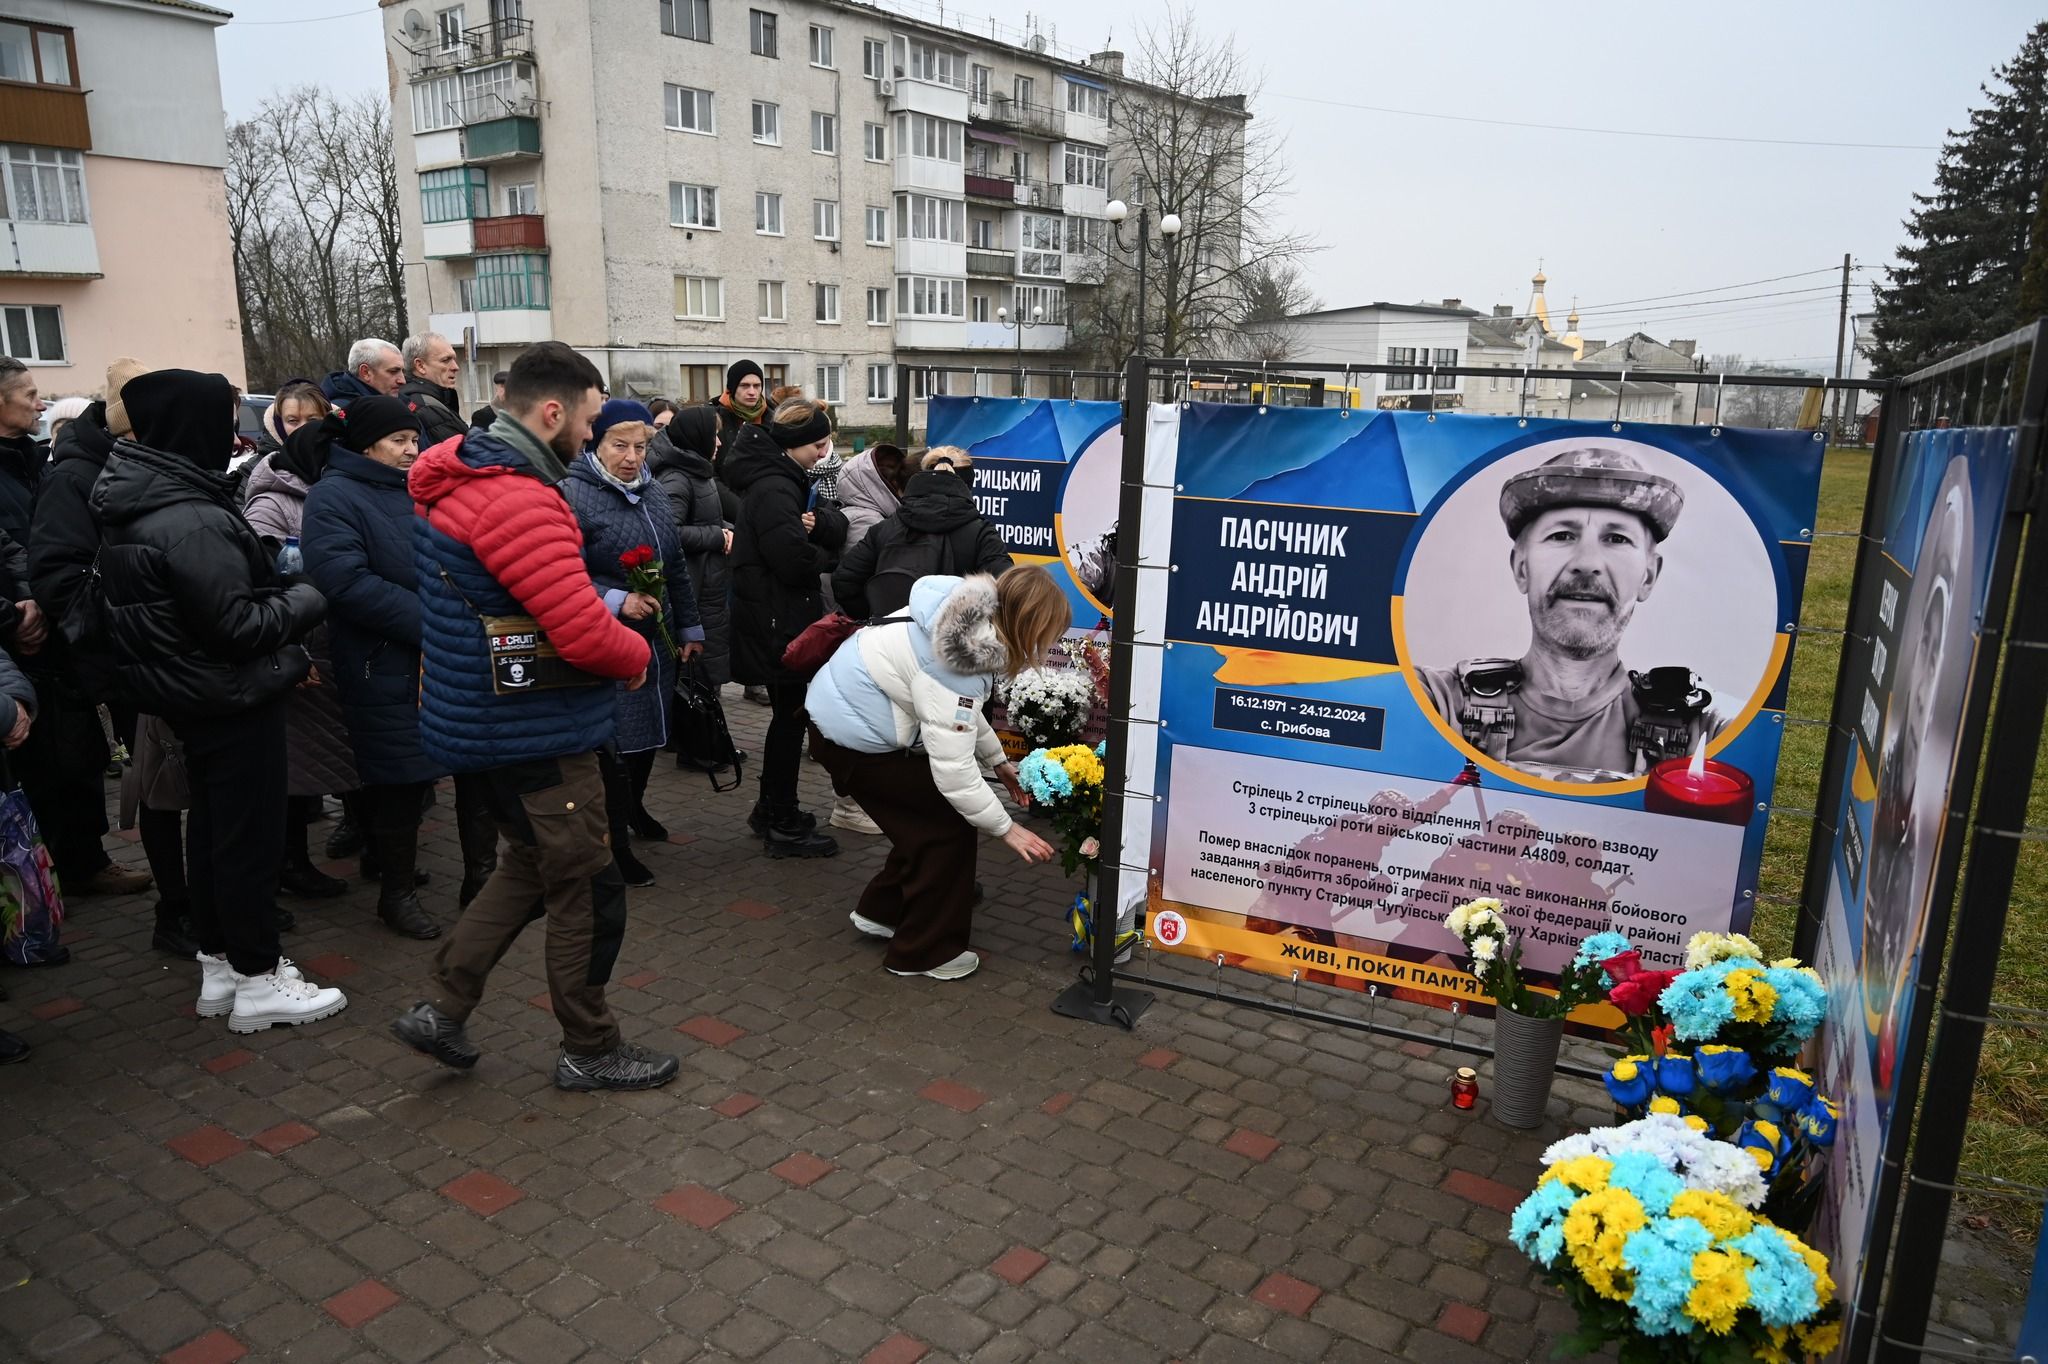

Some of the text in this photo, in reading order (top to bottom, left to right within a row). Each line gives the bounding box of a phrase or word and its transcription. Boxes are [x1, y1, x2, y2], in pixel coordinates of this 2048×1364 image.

[972, 468, 1041, 492] РИЦЬКИЙ
[1220, 516, 1349, 558] ПАСІЧНИК
[1230, 561, 1328, 600] АНДРІЙ
[1196, 600, 1359, 647] АНДРІЙОВИЧ
[1230, 695, 1287, 712] 16.12.1971
[1299, 704, 1367, 722] 24.12.2024
[1260, 720, 1331, 739] с. Грибова
[1232, 780, 1659, 862] Стрілець 2 стрілецького відділення 1 стрілецького взводу
[1248, 801, 1634, 876] 3 стрілецької роти військової частини А4809, солдат.
[1198, 830, 1688, 926] Помер внаслідок поранень, отриманих під час виконання бойового
[1199, 851, 1260, 871] завдання
[1263, 862, 1271, 873] з
[1274, 863, 1332, 884] відбиття
[1335, 873, 1399, 895] збройної
[1401, 886, 1450, 904] агресії
[1533, 907, 1612, 933] федерації
[1627, 925, 1681, 946] районі
[1190, 867, 1265, 890] населеного
[1267, 881, 1312, 901] пункту
[1315, 887, 1373, 910] Стариця
[1377, 899, 1449, 923] Чугуївськ
[1529, 925, 1584, 948] Харків
[1632, 944, 1685, 967] бласті
[1280, 942, 1341, 971] ЖИВІ,
[1346, 956, 1405, 980] ПОКИ
